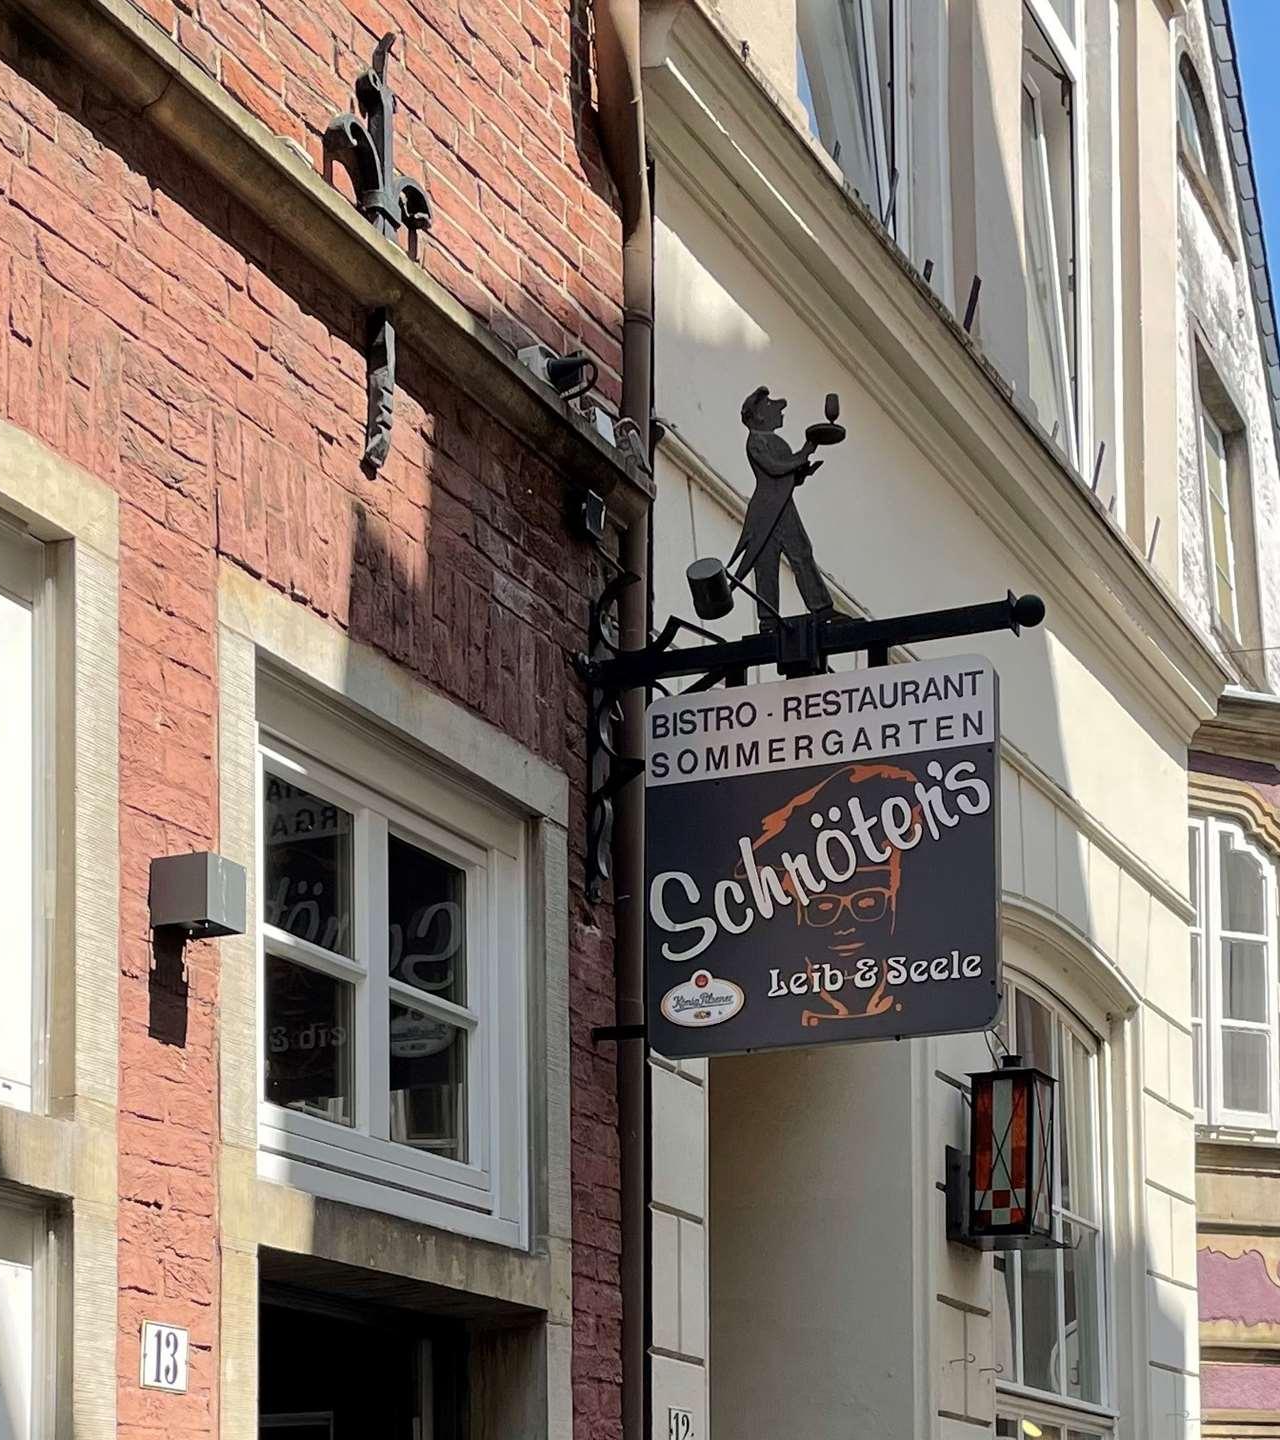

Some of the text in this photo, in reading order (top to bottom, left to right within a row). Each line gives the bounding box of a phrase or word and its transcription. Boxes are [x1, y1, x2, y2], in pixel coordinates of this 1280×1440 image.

[652, 701, 756, 739] BISTRO
[783, 670, 984, 722] RESTAURANT
[651, 710, 984, 778] SOMMERGARTEN
[768, 950, 983, 998] Leib & Seele
[153, 1328, 180, 1385] 13
